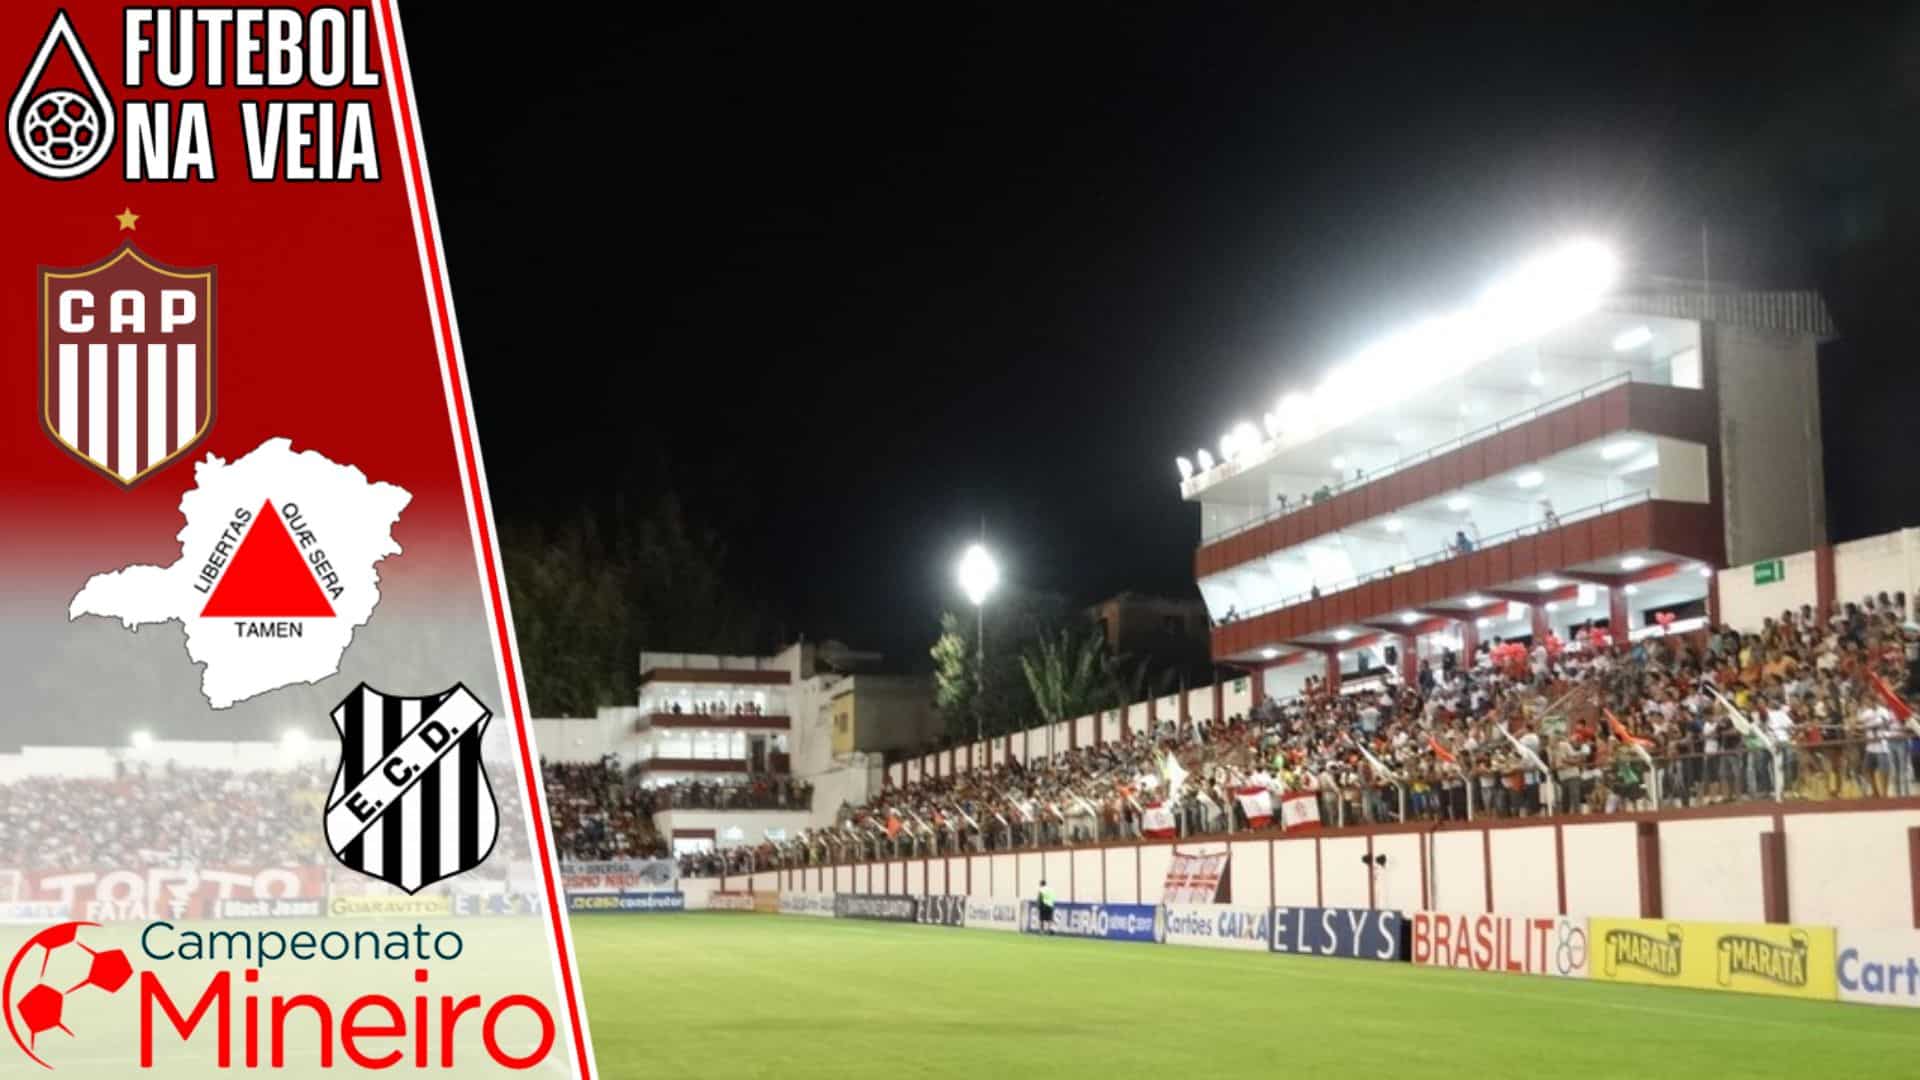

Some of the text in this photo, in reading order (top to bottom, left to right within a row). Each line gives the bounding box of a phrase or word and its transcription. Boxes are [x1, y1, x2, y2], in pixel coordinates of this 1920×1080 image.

[40, 868, 302, 919] TORTO
[331, 897, 439, 915] GUARAVITO
[455, 895, 543, 915] ELSY
[916, 896, 965, 925] ELSYS
[1030, 904, 1109, 937] BSILEIRÃO
[1166, 909, 1213, 938] Cartões
[1218, 911, 1271, 942] CAIXA
[1273, 908, 1397, 960] ELSYS
[1413, 914, 1554, 976] BRASILIT
[1836, 948, 1919, 996] Cart
